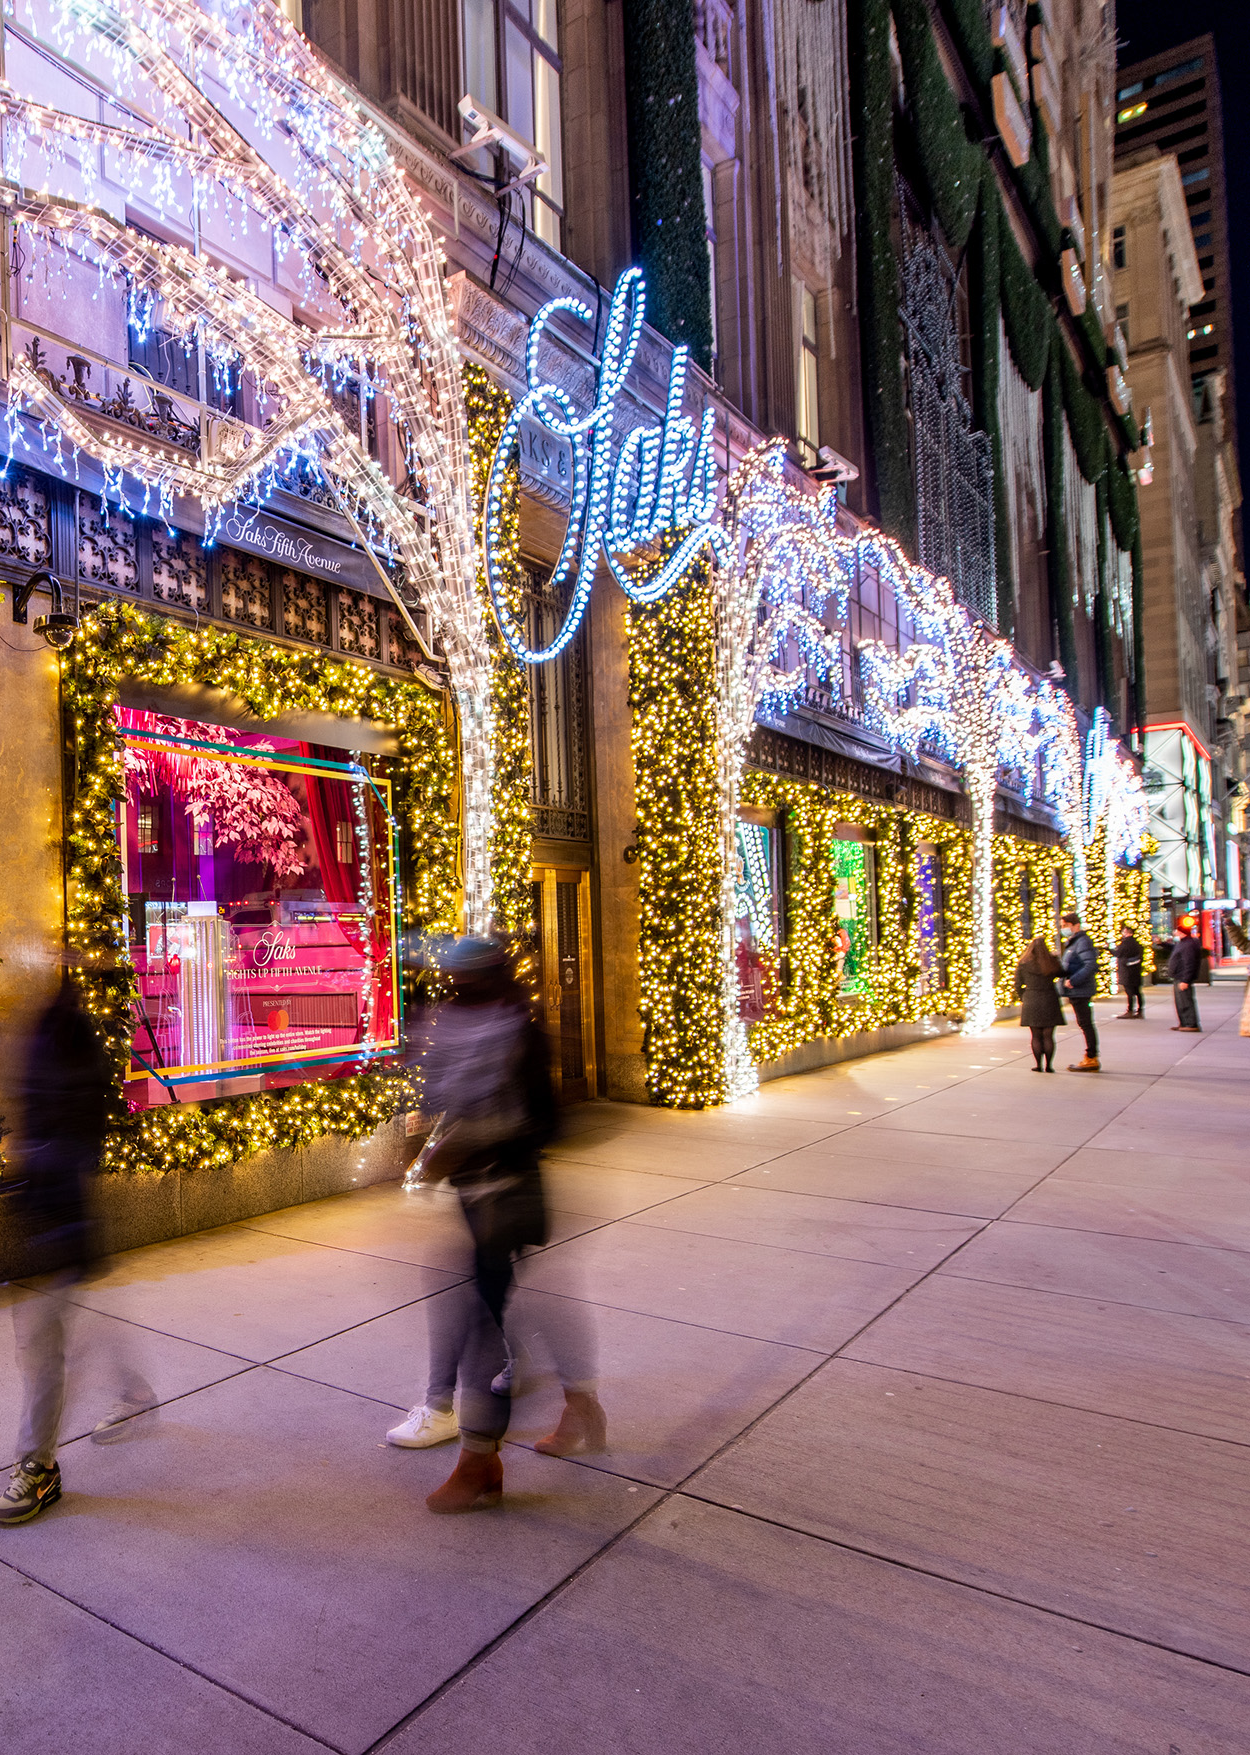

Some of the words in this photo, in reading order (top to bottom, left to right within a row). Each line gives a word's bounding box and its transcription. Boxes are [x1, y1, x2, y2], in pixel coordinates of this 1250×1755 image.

[483, 266, 739, 664] Saks
[226, 513, 266, 547] Saks
[263, 526, 297, 560] Fifth
[291, 538, 342, 574] Avenue
[227, 968, 257, 980] LIGHTS
[258, 968, 269, 979] UP
[270, 967, 293, 978] FIFTH
[294, 965, 323, 977] AVENUE
[253, 931, 296, 966] Saks
